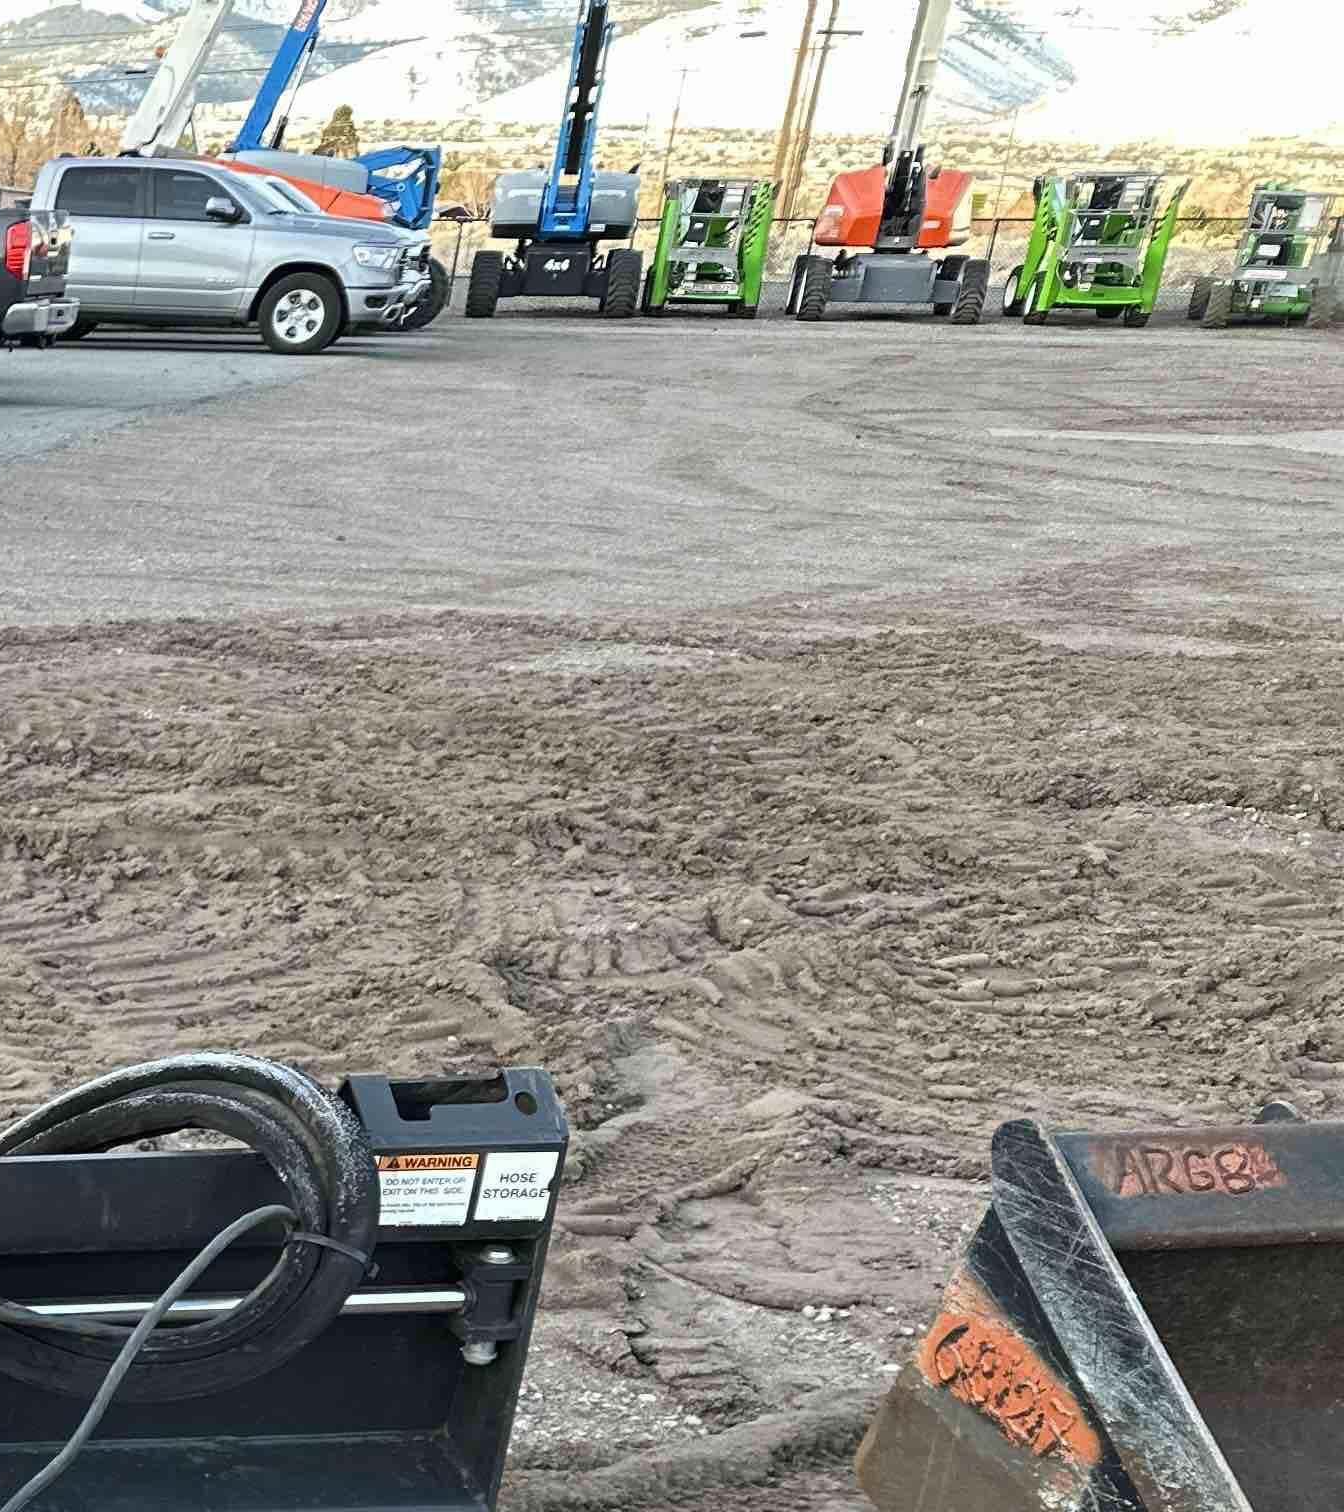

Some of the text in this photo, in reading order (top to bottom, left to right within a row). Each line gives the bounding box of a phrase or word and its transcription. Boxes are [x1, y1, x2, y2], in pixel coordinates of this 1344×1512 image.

[404, 1156, 473, 1169] WARNING
[499, 1172, 538, 1183] HOSE
[482, 1188, 549, 1199] STORAGE
